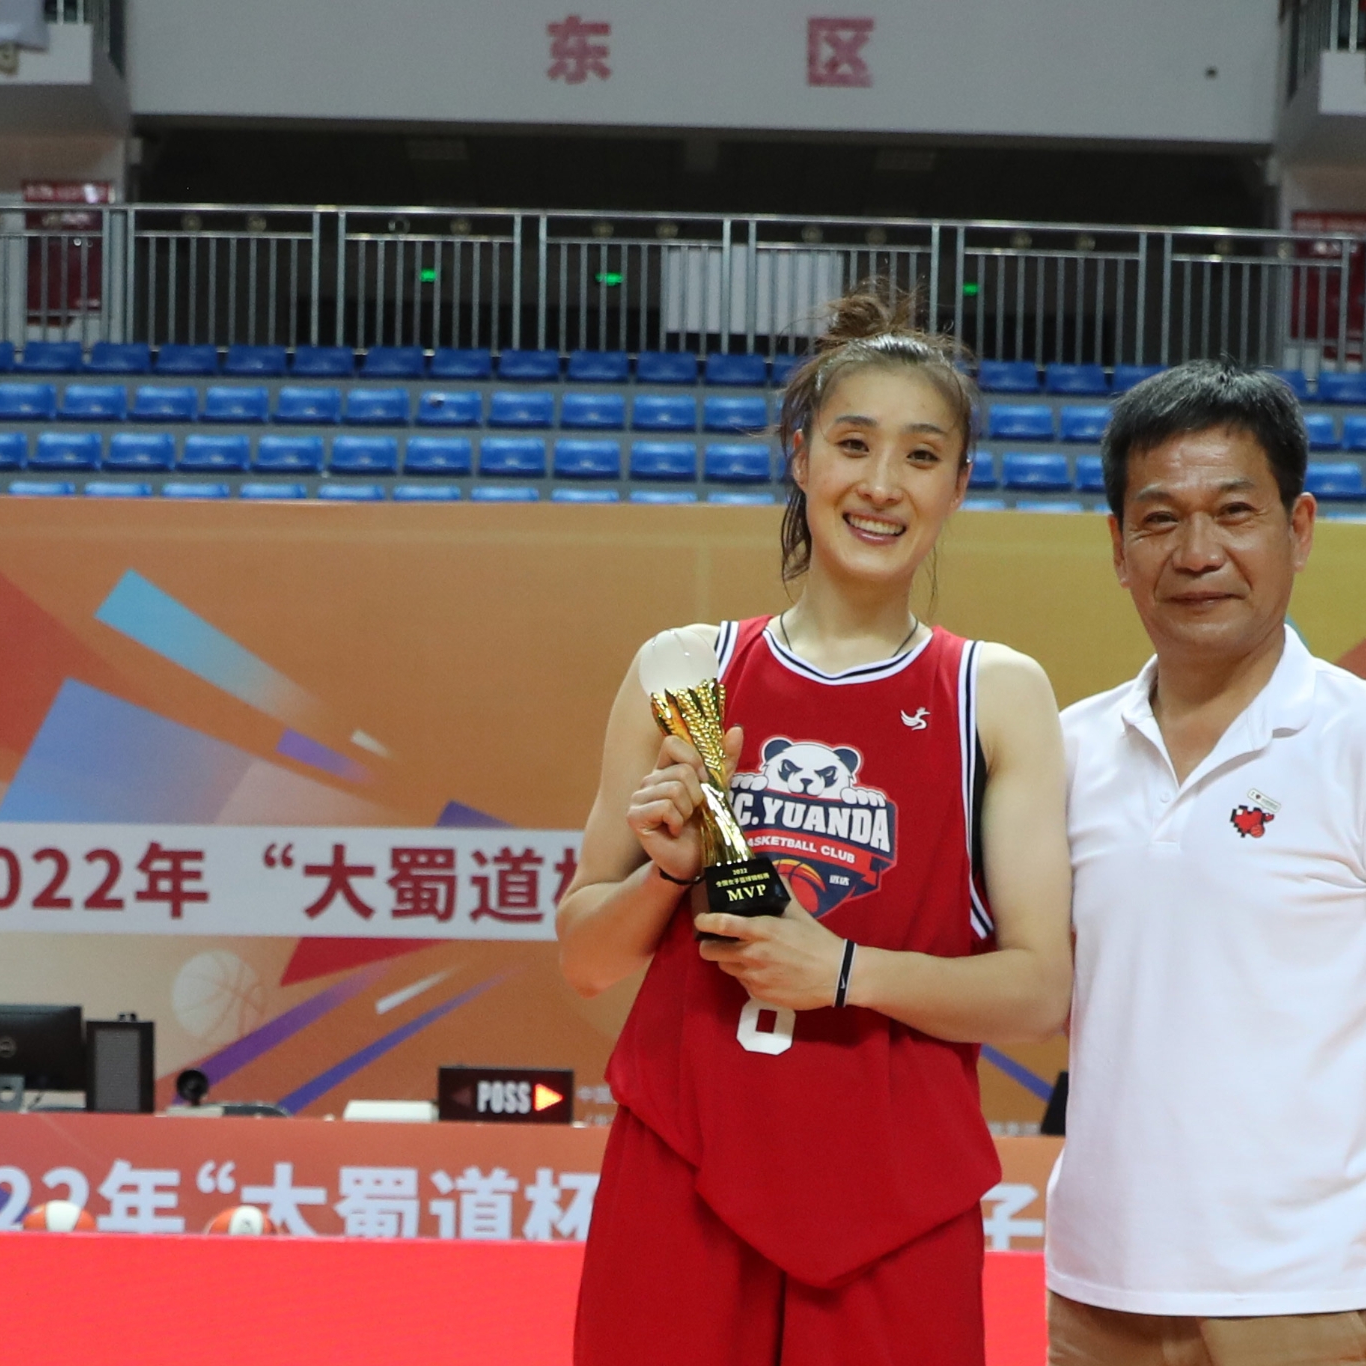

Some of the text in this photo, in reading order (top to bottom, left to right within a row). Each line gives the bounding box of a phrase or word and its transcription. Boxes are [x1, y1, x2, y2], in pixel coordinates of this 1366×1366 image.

[546, 16, 876, 88] 东区
[732, 791, 891, 852] C.YUANDA
[748, 835, 856, 864] ASKETBALL CLUB
[726, 884, 767, 902] MVP
[477, 1080, 531, 1114] POSS
